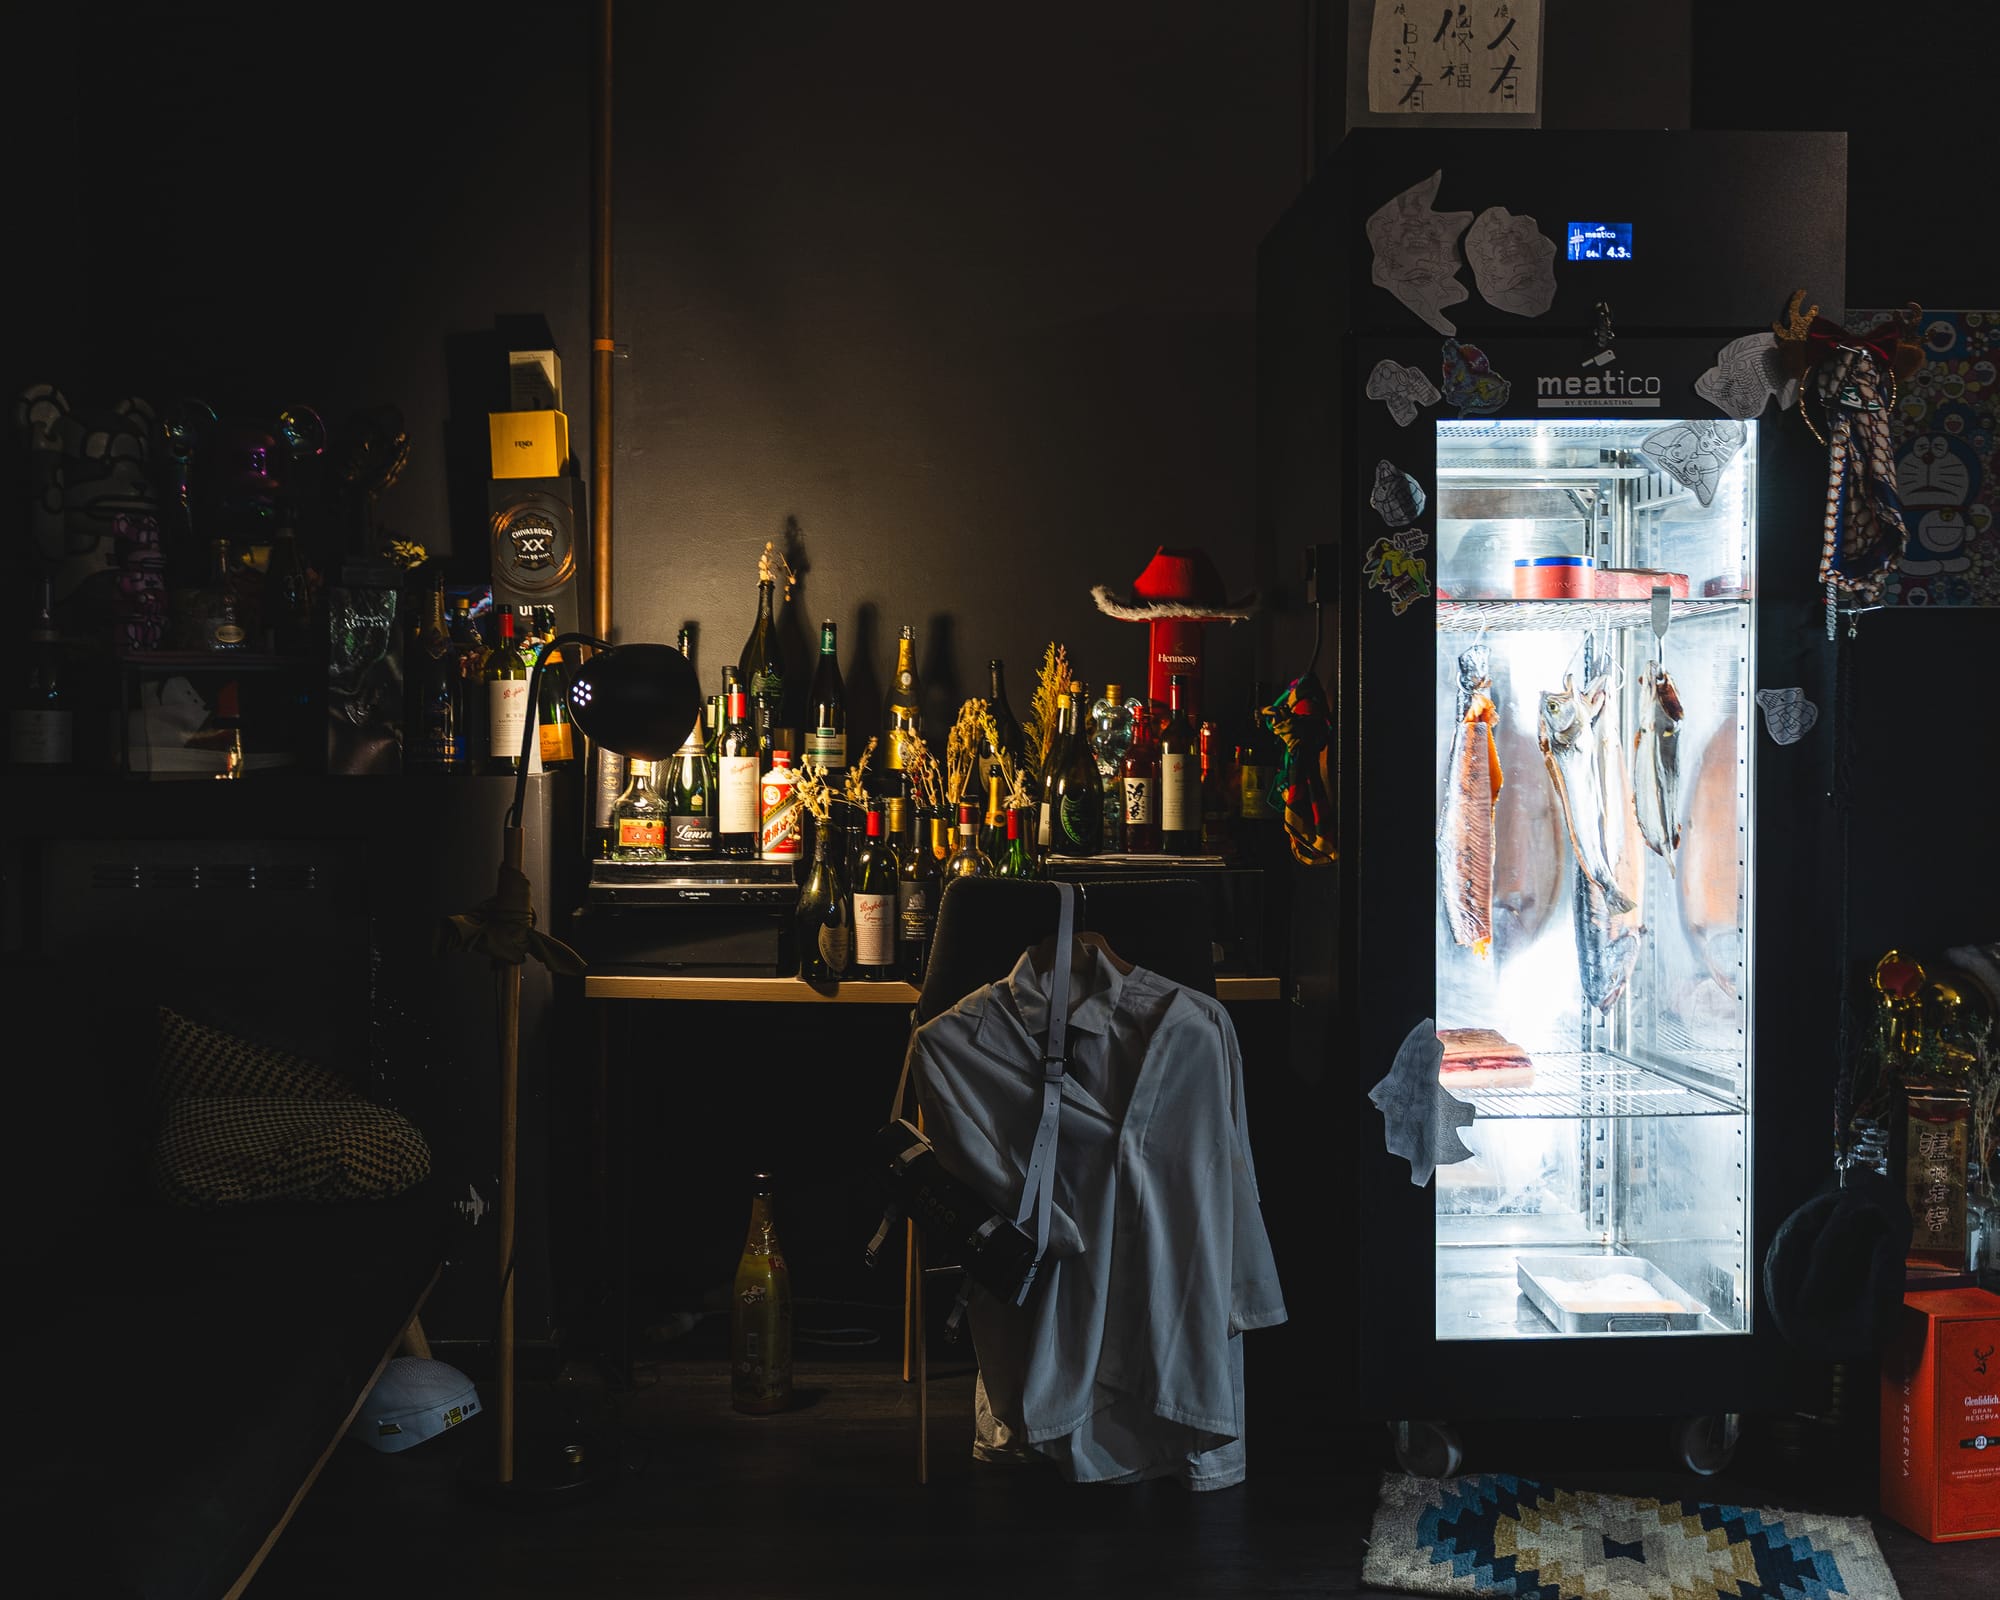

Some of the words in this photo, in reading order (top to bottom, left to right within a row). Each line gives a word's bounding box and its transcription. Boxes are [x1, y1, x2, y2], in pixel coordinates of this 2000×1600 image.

[1537, 370, 1661, 395] meatico
[514, 441, 533, 449] FENDI
[511, 527, 534, 539] CHIVAS
[533, 527, 553, 537] REGAL
[521, 538, 545, 552] XX
[1157, 653, 1197, 665] Hennessy
[1964, 1394, 1999, 1407] Glenfiddich
[1965, 1413, 1999, 1423] RESERVA
[1976, 1437, 1985, 1446] 21
